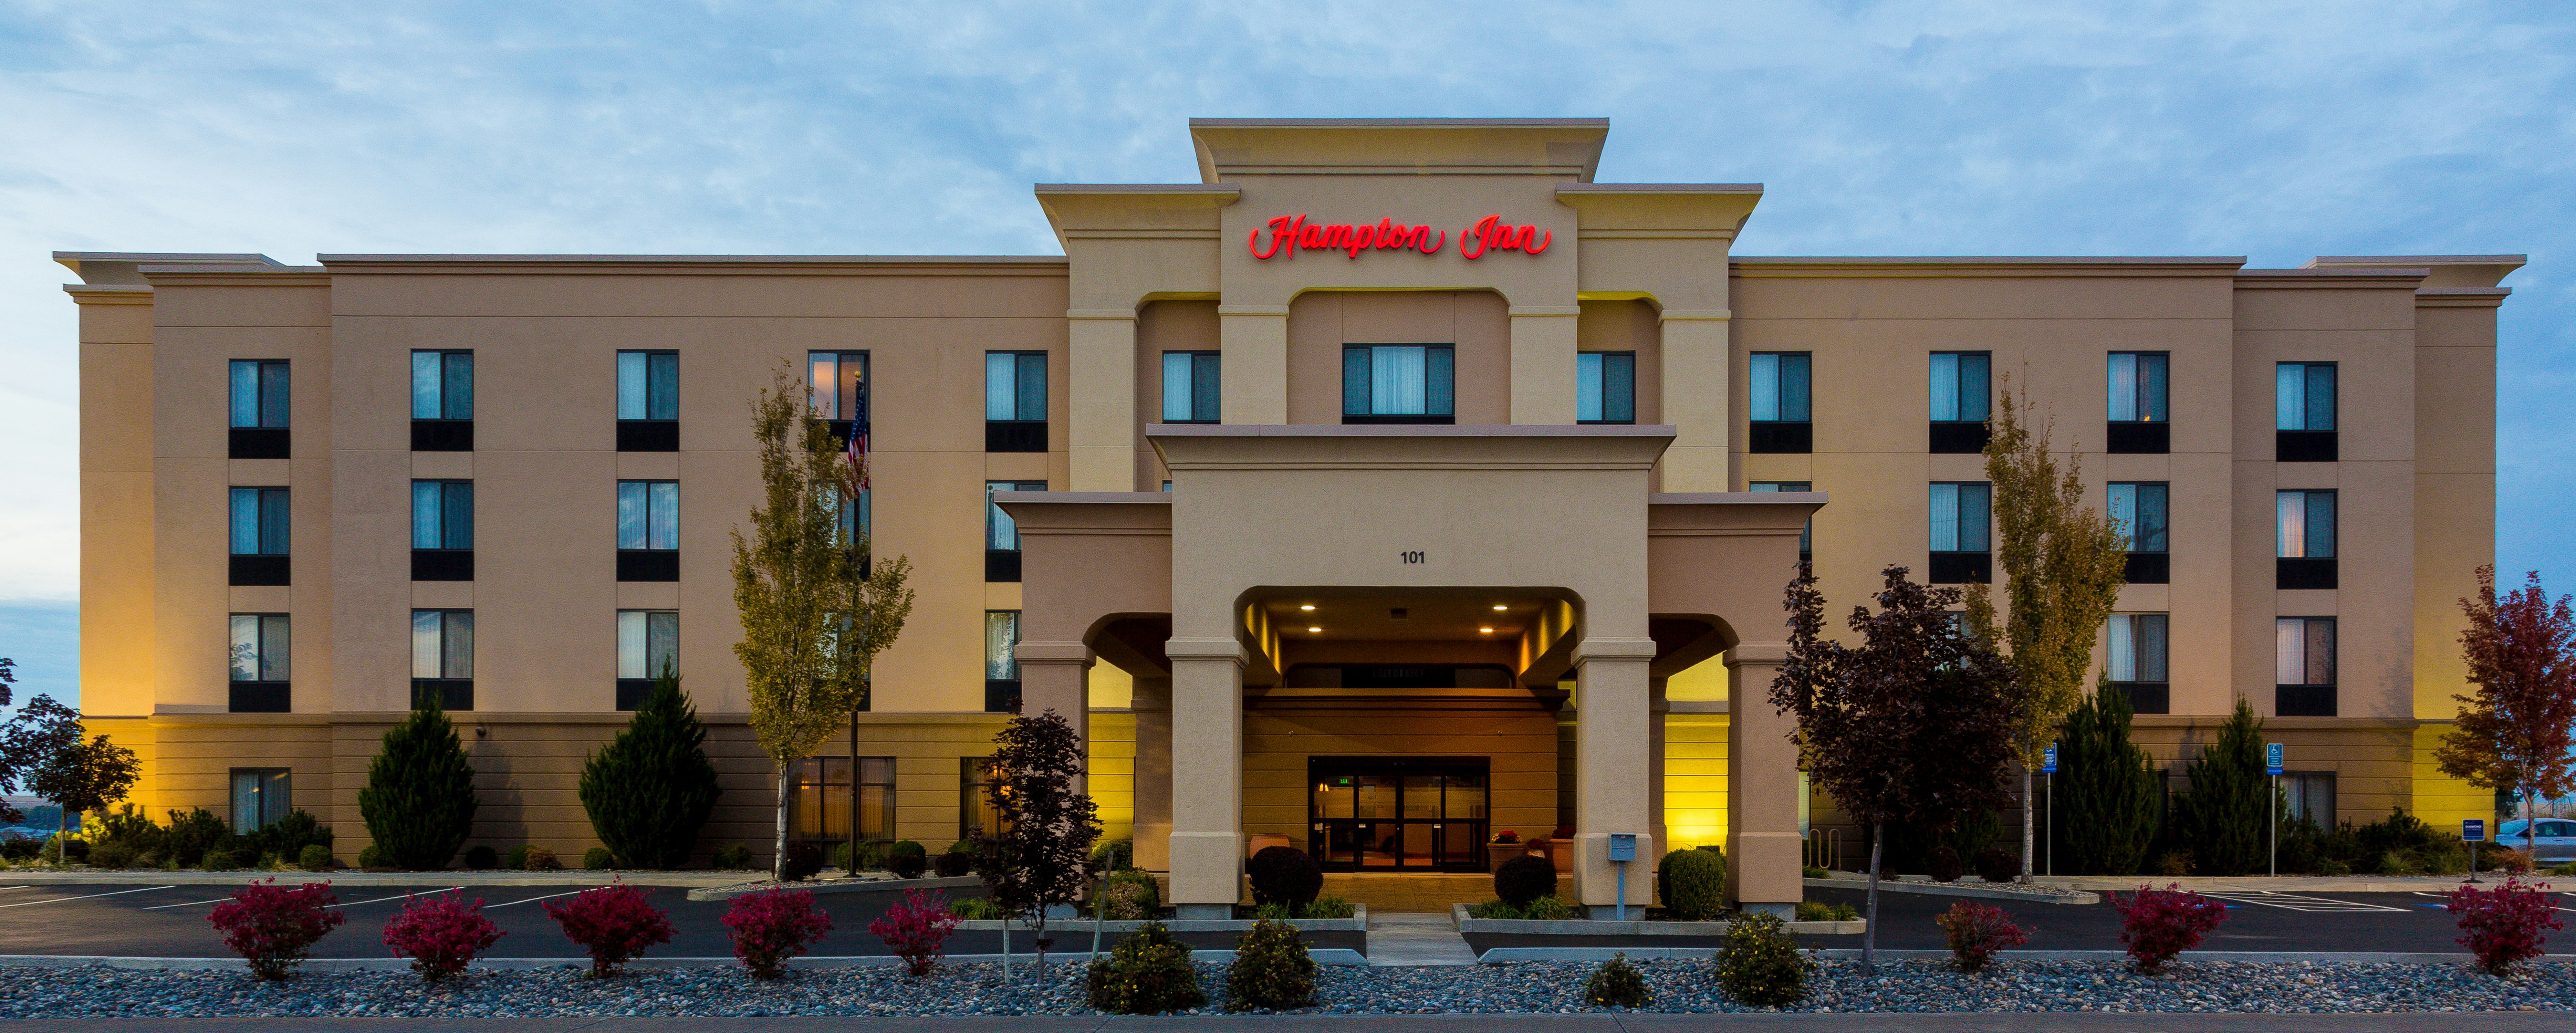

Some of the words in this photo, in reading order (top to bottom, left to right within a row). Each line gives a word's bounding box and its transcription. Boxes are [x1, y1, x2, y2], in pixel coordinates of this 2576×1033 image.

[1249, 213, 1446, 260] Hampton
[1459, 214, 1552, 260] Inn
[1401, 551, 1425, 564] 101
